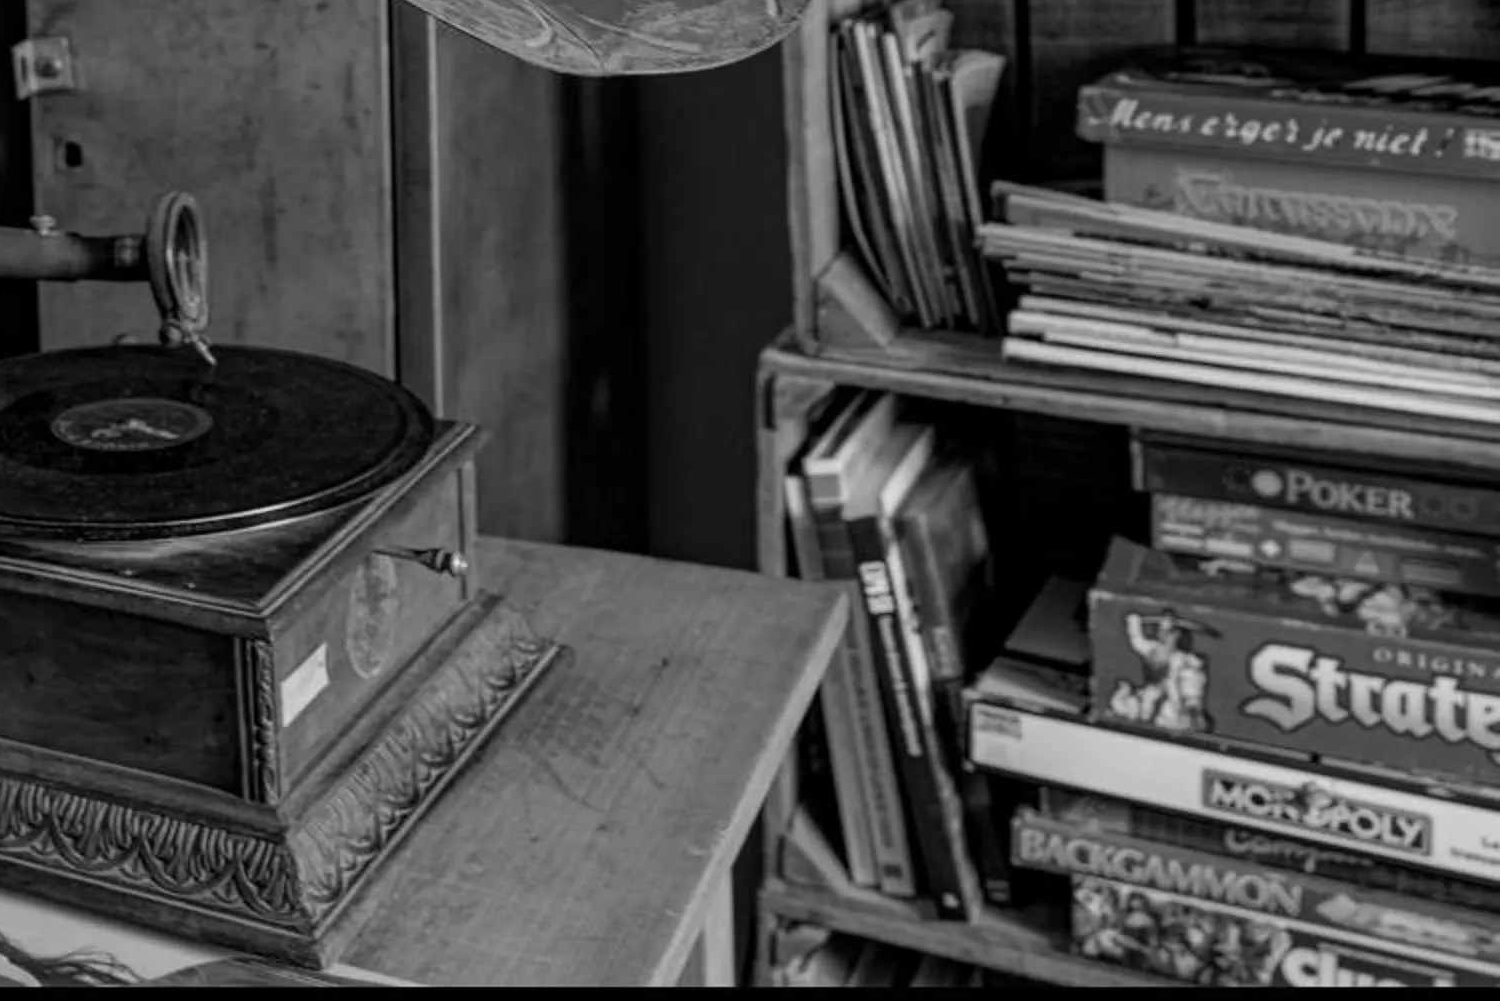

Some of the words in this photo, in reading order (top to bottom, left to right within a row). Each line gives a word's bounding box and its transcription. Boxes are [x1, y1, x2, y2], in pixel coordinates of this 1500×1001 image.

[1303, 118, 1344, 151] je
[1285, 469, 1416, 520] POKER
[1242, 643, 1500, 751] Strate
[1018, 828, 1304, 918] BACKGAMMON
